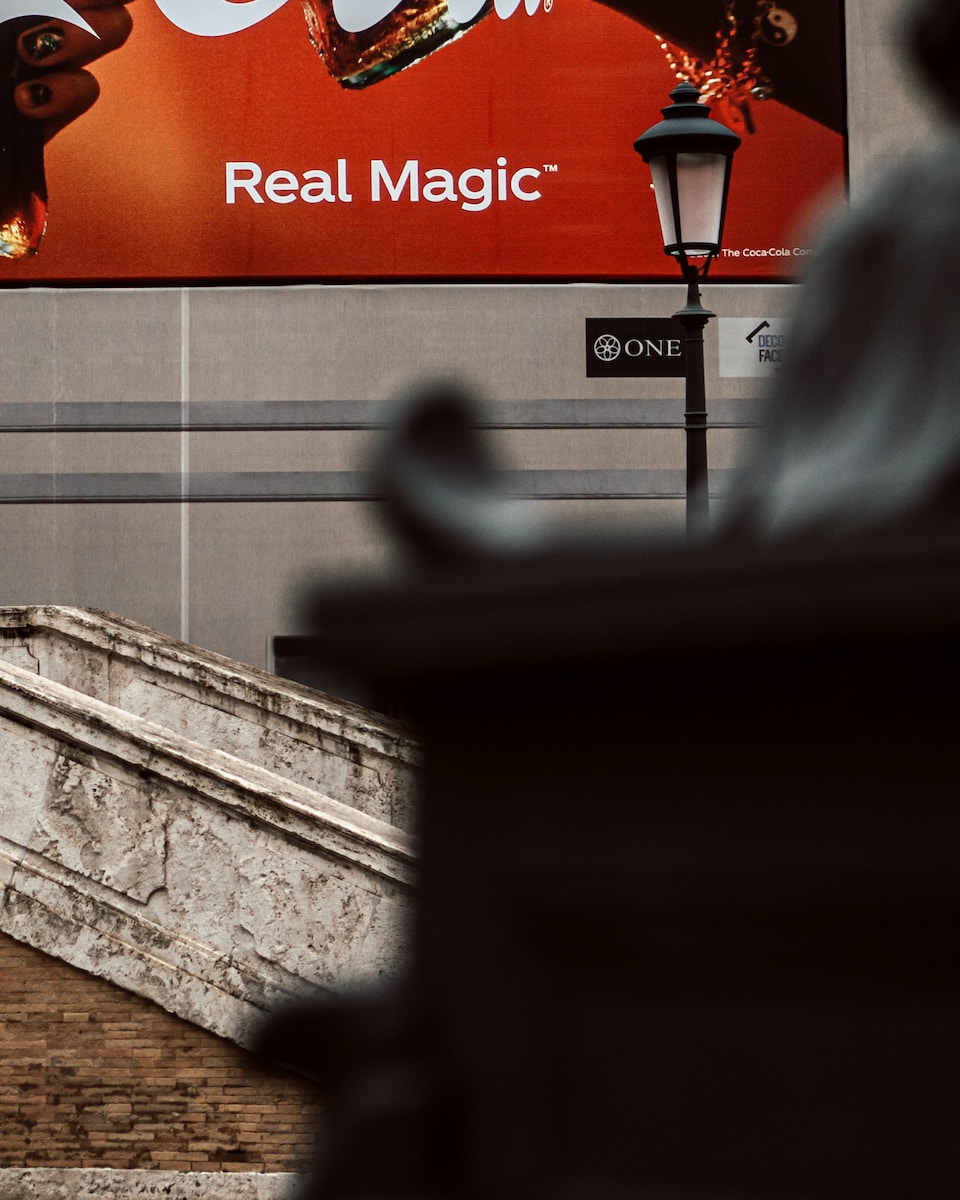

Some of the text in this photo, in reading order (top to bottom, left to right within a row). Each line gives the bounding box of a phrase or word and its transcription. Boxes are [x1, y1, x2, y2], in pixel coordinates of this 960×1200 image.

[225, 158, 353, 205] Real
[722, 248, 741, 258] The
[742, 247, 791, 257] Coca-Cola
[624, 338, 682, 357] ONE
